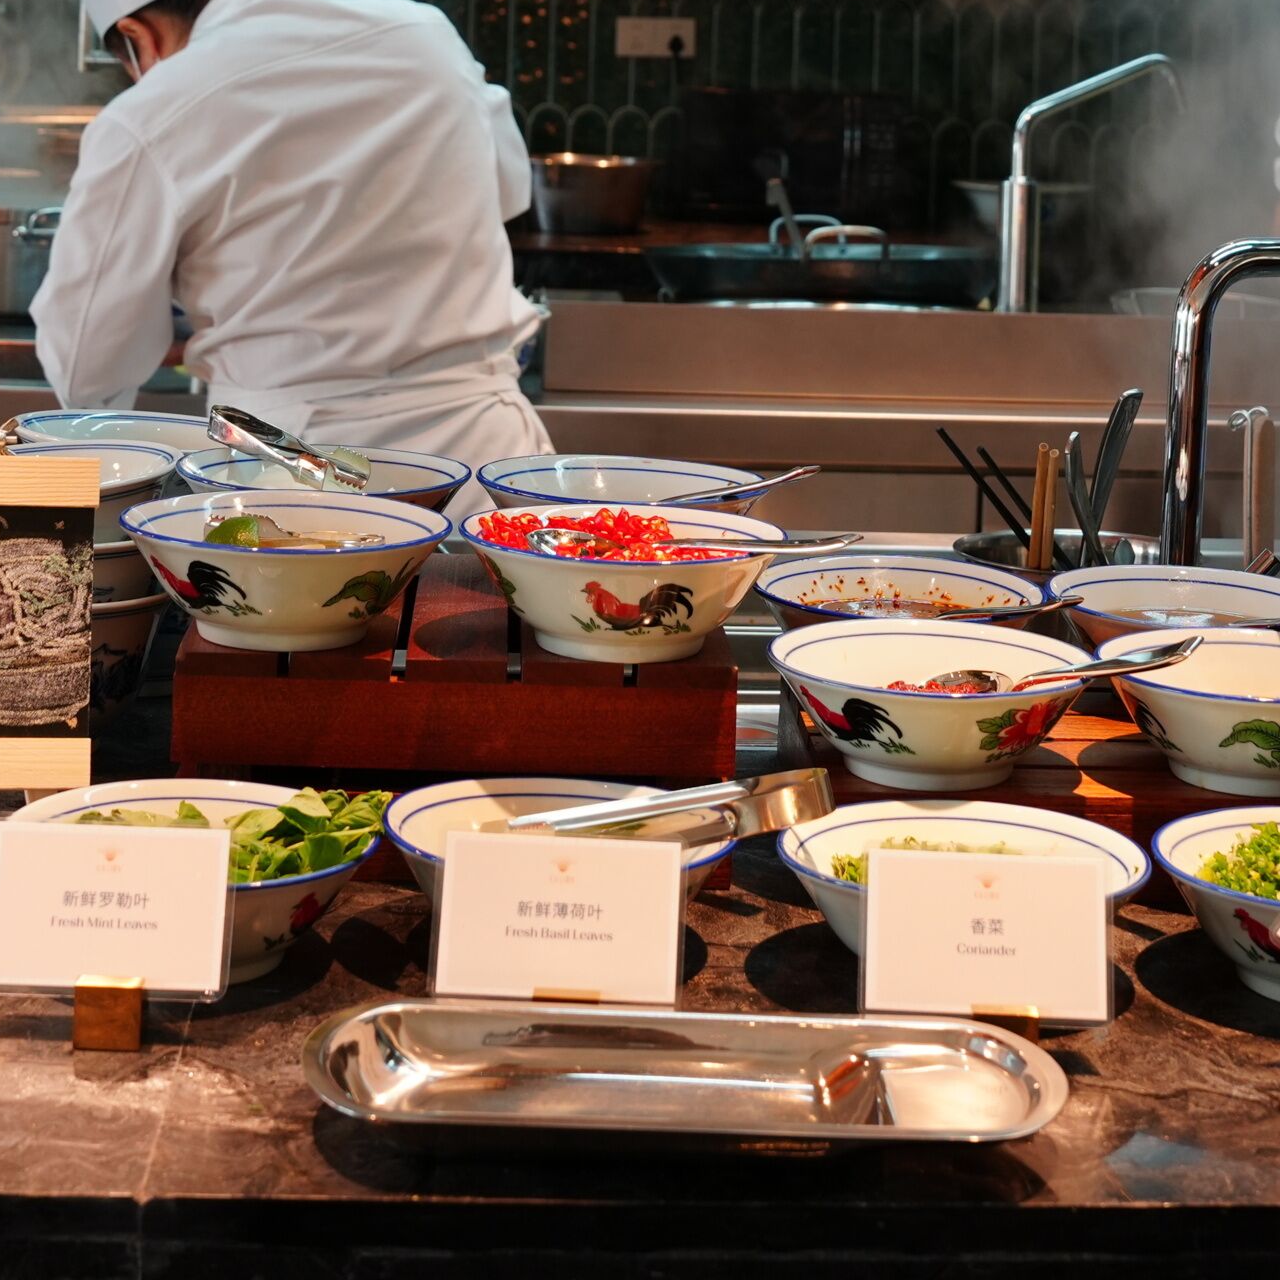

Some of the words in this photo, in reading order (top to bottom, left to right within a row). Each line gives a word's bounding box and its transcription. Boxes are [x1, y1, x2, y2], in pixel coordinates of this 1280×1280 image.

[63, 890, 150, 909] 新鲜罗勒叶
[517, 900, 603, 920] 新鲜薄荷叶
[50, 915, 84, 928] Fresh
[88, 917, 113, 929] Mint
[117, 918, 158, 930] Leaves
[970, 918, 1004, 936] 香菜
[505, 925, 538, 938] Fresh
[541, 927, 570, 939] Basil
[573, 929, 613, 941] Leaves
[956, 942, 1016, 956] Coriander
